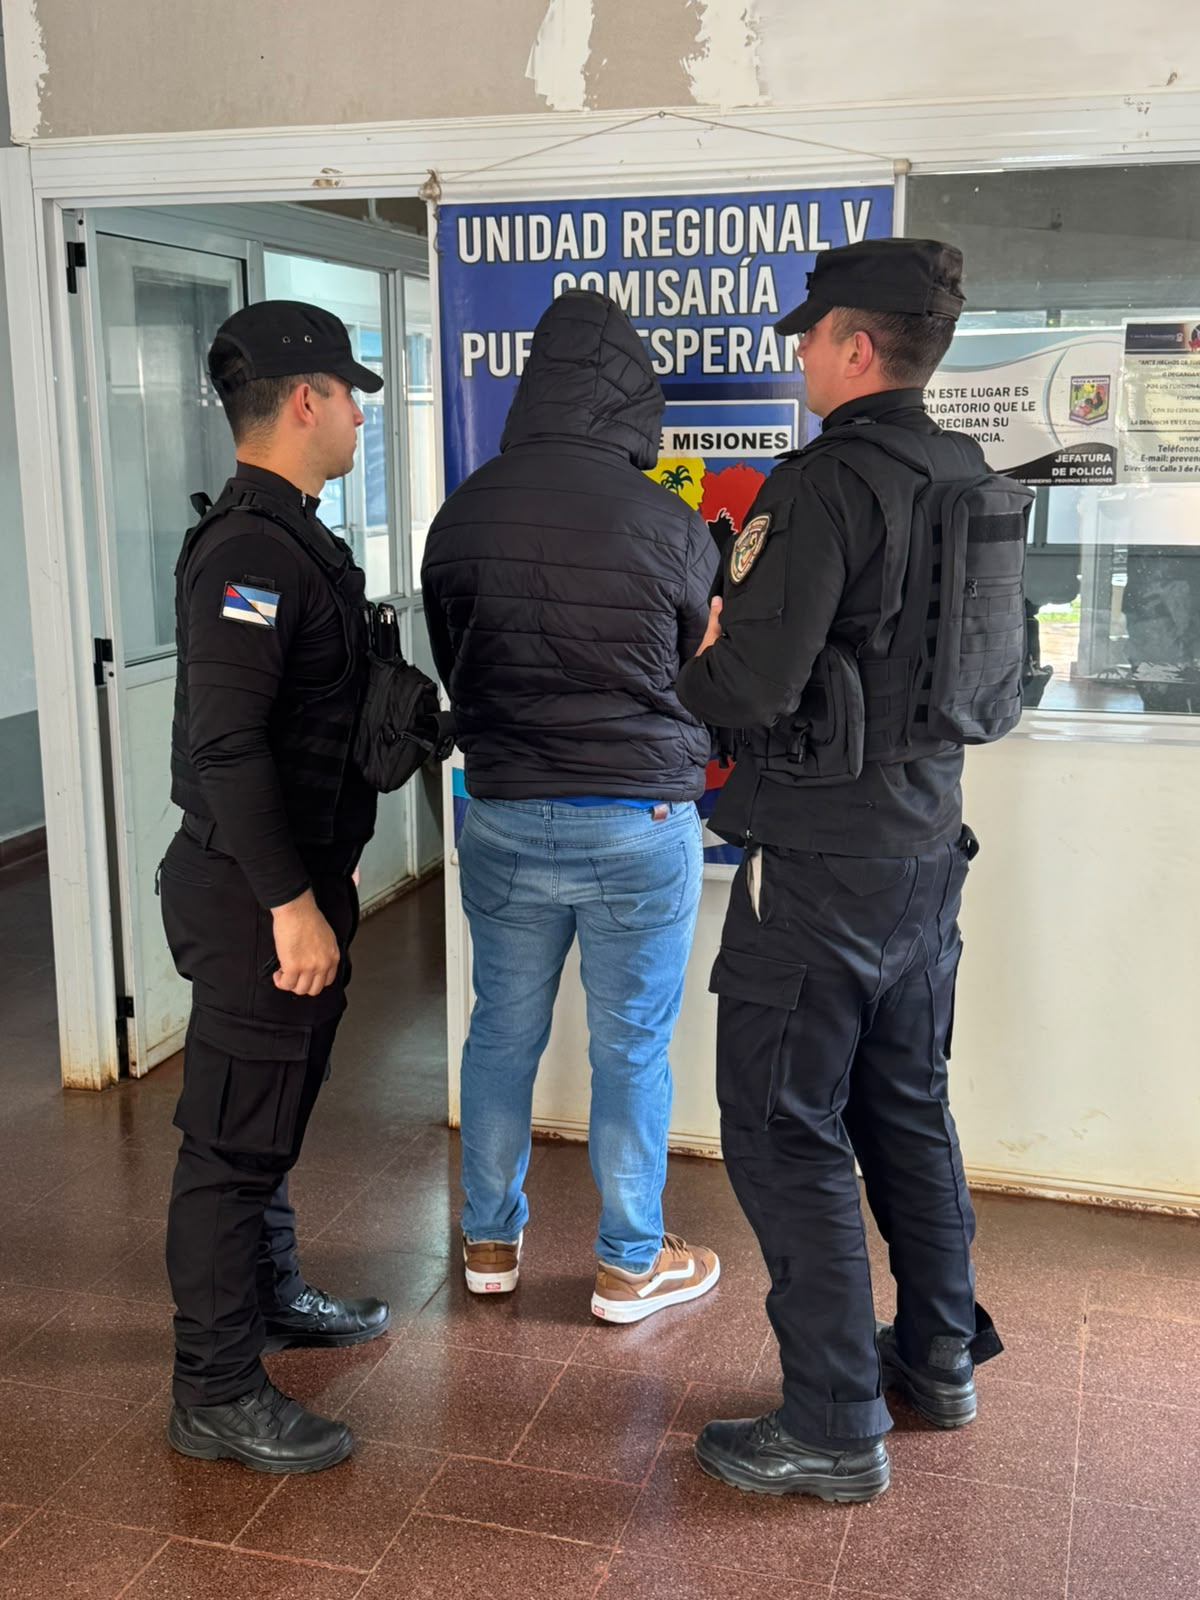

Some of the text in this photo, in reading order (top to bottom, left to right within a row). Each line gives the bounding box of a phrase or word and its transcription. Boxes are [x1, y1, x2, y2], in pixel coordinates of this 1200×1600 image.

[457, 200, 871, 264] UNIDAD REGIONAL V
[939, 388, 968, 399] ESTE
[971, 387, 1011, 398] LUGAR
[1014, 386, 1029, 397] ES
[924, 401, 1036, 414] BLIGATORIO QUE LE
[938, 417, 1009, 429] RECIBAN SU
[672, 432, 789, 451] MISIONES
[1055, 453, 1112, 463] JEFATURA
[1140, 453, 1200, 465] E-mail: preven
[1051, 465, 1114, 476] DE POLICÍA
[1159, 464, 1178, 473] Calle
[1184, 464, 1193, 473] de
